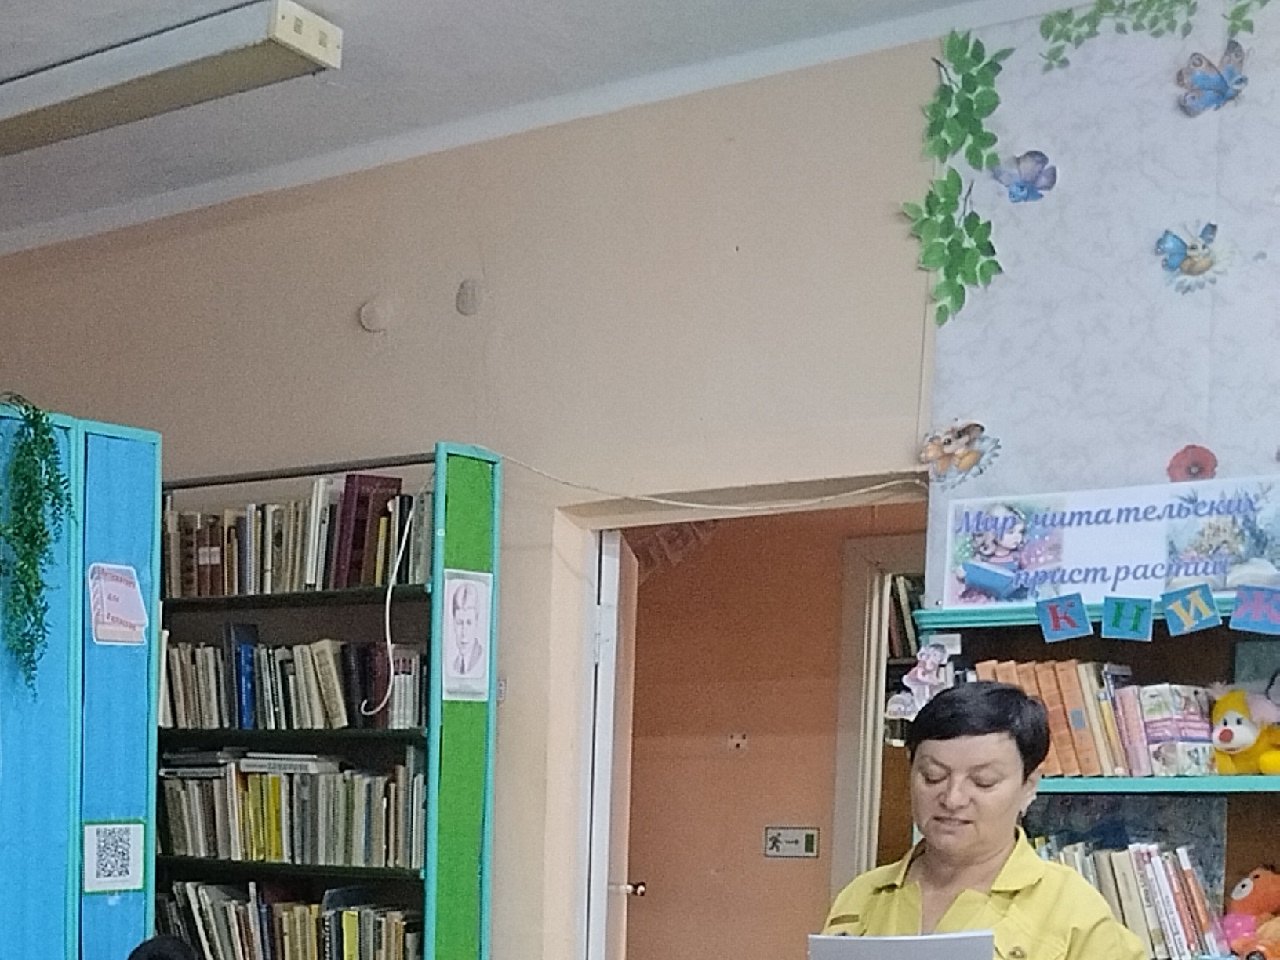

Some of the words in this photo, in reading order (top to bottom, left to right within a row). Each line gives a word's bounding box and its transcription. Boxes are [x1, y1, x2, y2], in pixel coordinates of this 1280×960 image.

[955, 510, 1017, 539] Мир
[1030, 496, 1261, 528] читательских
[1011, 556, 1230, 597] пристрастий
